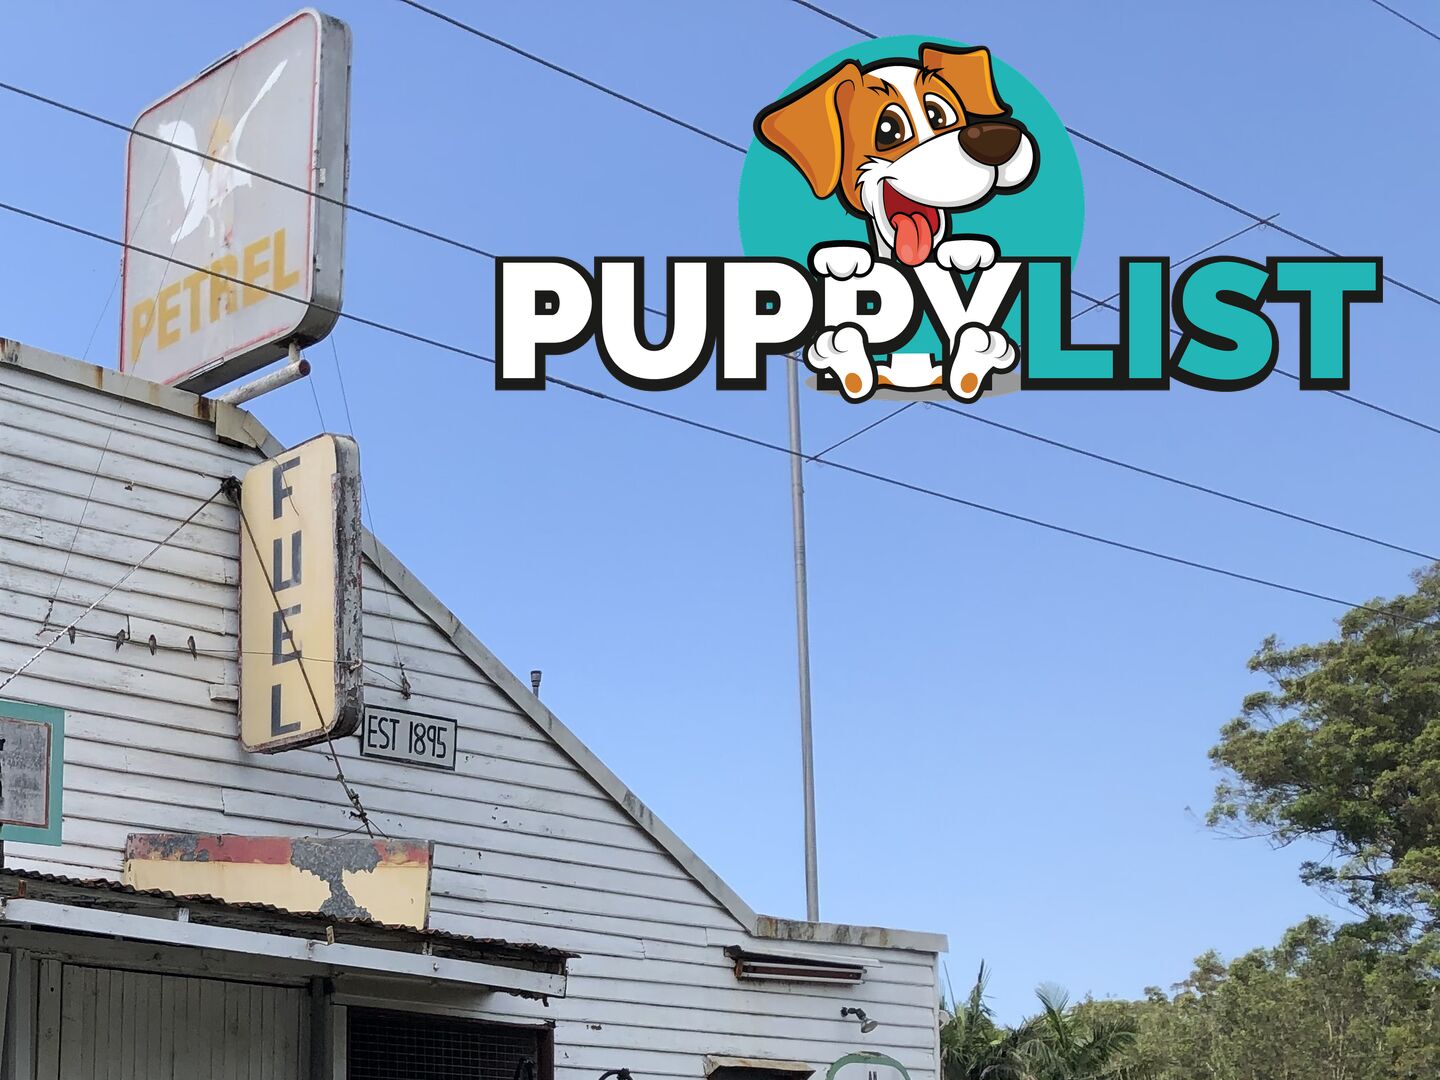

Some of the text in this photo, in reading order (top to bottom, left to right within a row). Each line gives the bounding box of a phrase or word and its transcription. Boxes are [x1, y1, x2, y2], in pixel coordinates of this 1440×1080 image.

[130, 228, 301, 364] PETREL
[271, 456, 302, 737] FUEL
[367, 714, 448, 758] EST 1895
